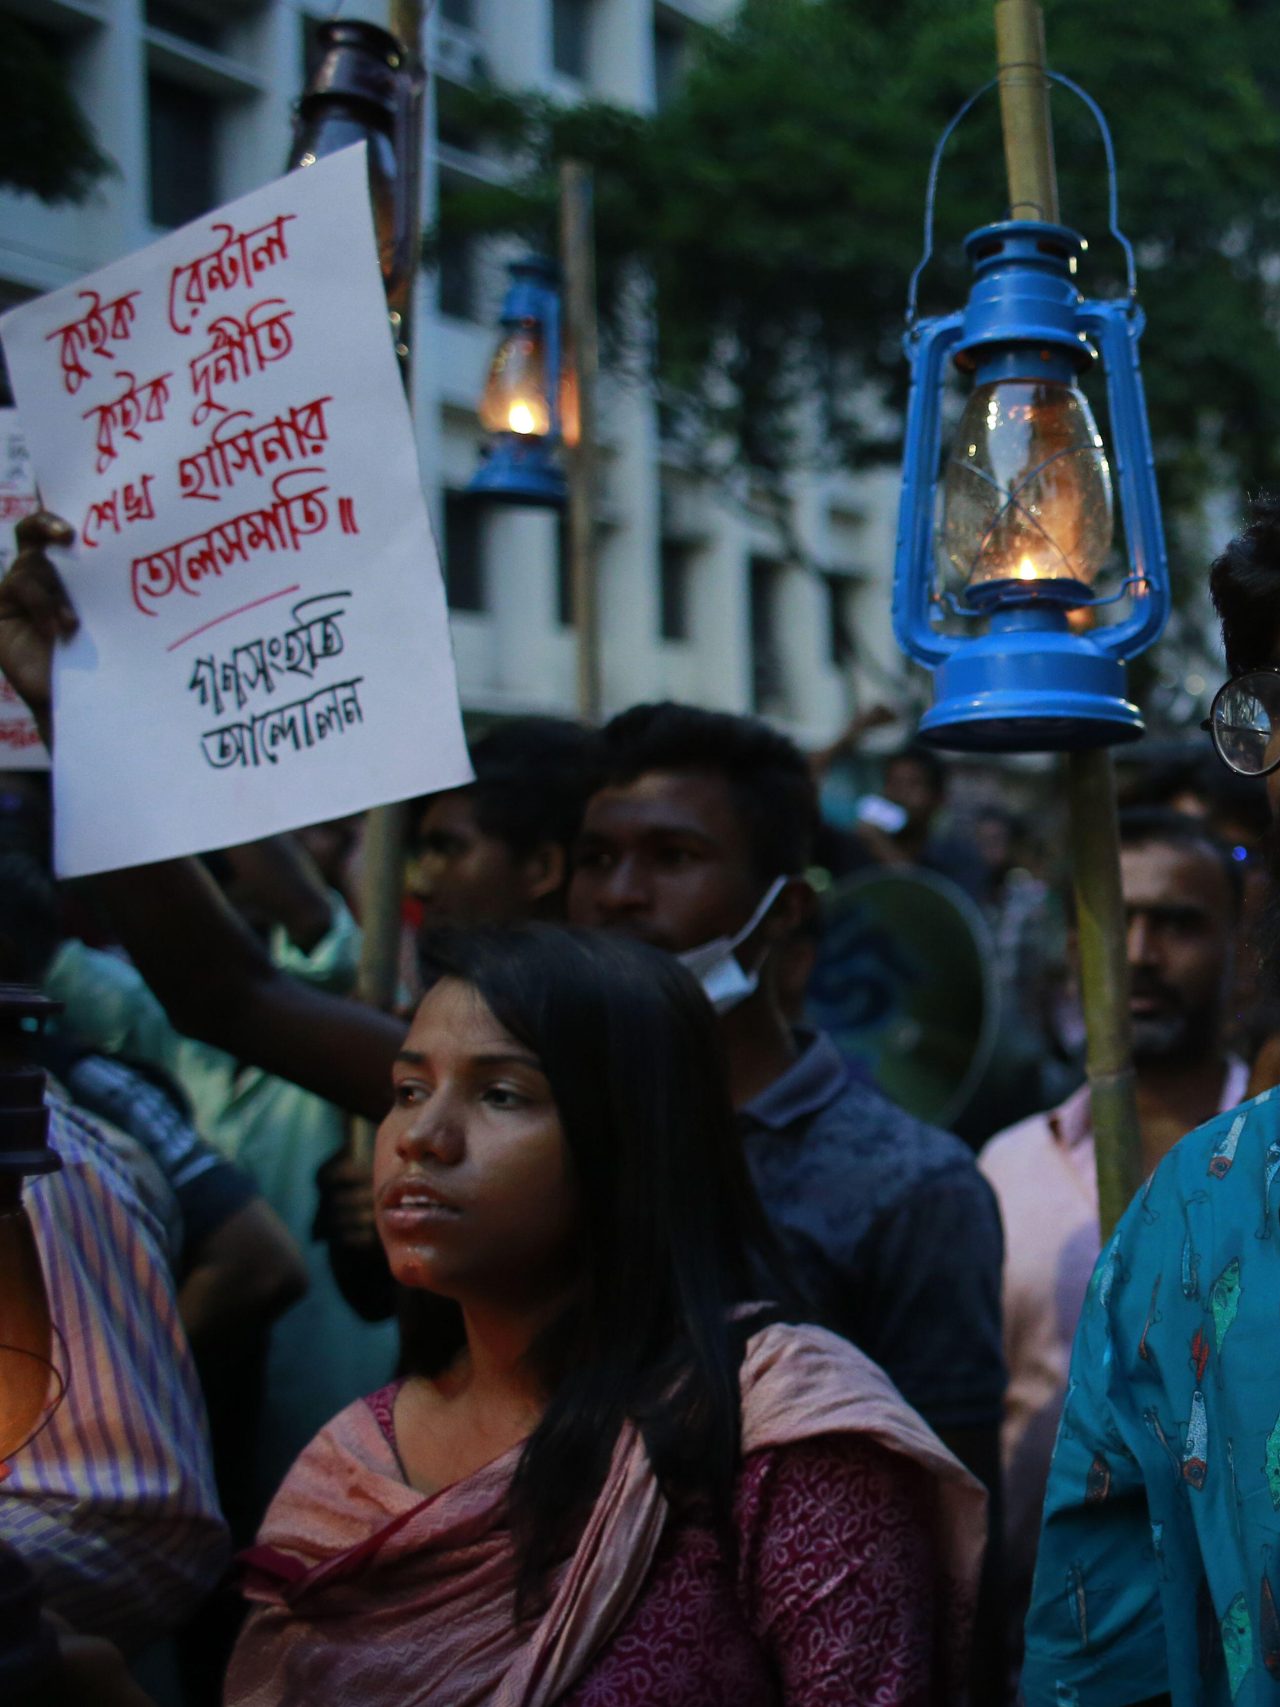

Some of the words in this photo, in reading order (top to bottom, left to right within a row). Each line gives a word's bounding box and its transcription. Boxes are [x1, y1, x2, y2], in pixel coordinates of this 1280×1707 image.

[45, 290, 142, 395] কুইক
[168, 213, 298, 336] রেন্টাল
[82, 370, 174, 474] কুইক
[189, 298, 296, 427] দুর্নীতি
[82, 473, 157, 548] শেখ
[178, 396, 334, 501] হাসিনার
[188, 590, 353, 717] গণসংহতি
[201, 675, 365, 770] আন্দোলন
